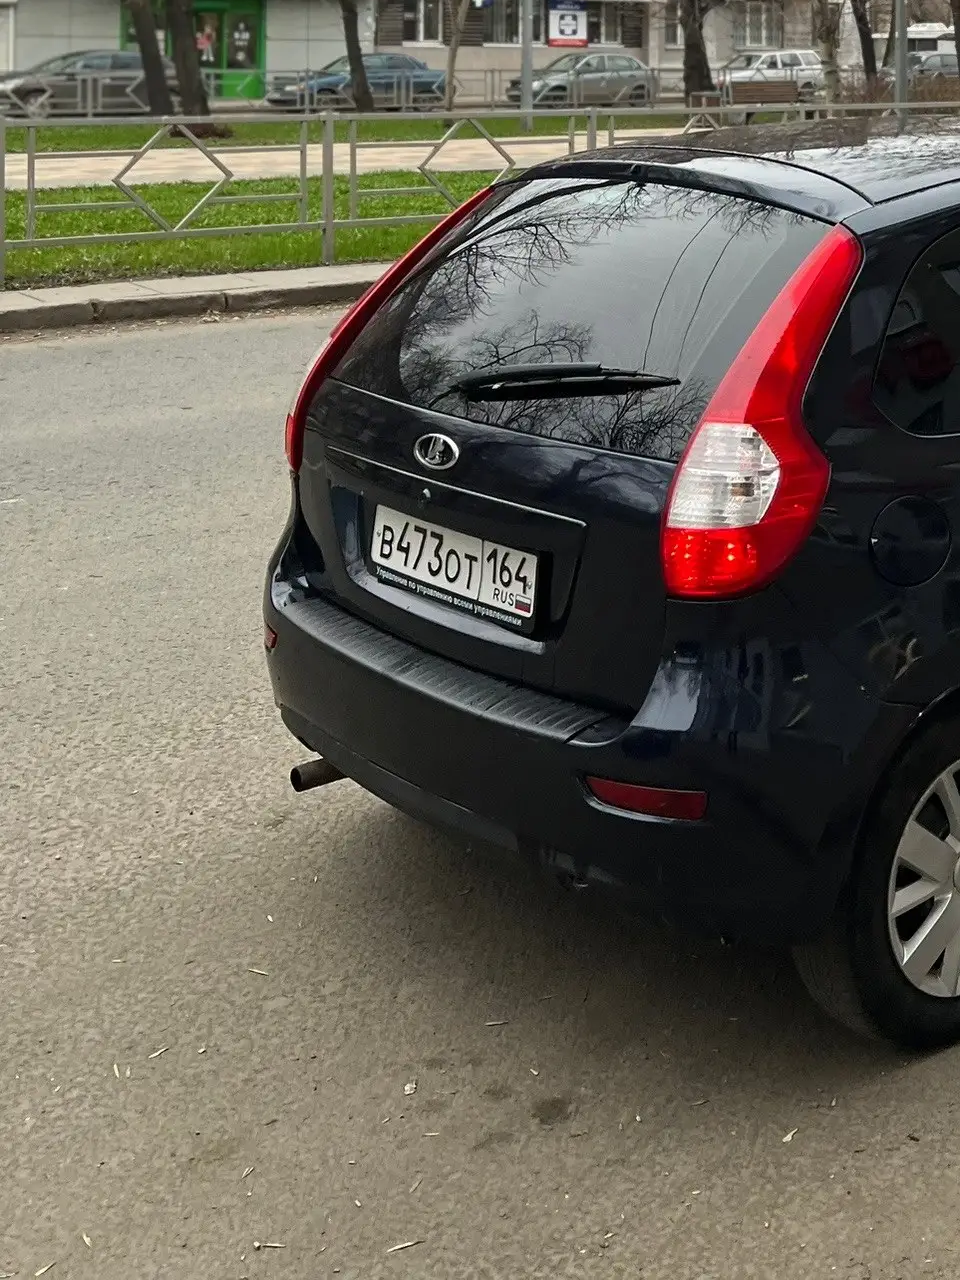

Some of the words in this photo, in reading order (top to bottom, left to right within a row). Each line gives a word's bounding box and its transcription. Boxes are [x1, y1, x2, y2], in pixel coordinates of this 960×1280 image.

[380, 522, 478, 590] В473ОТ
[486, 548, 528, 595] 164
[493, 588, 515, 607] RUS
